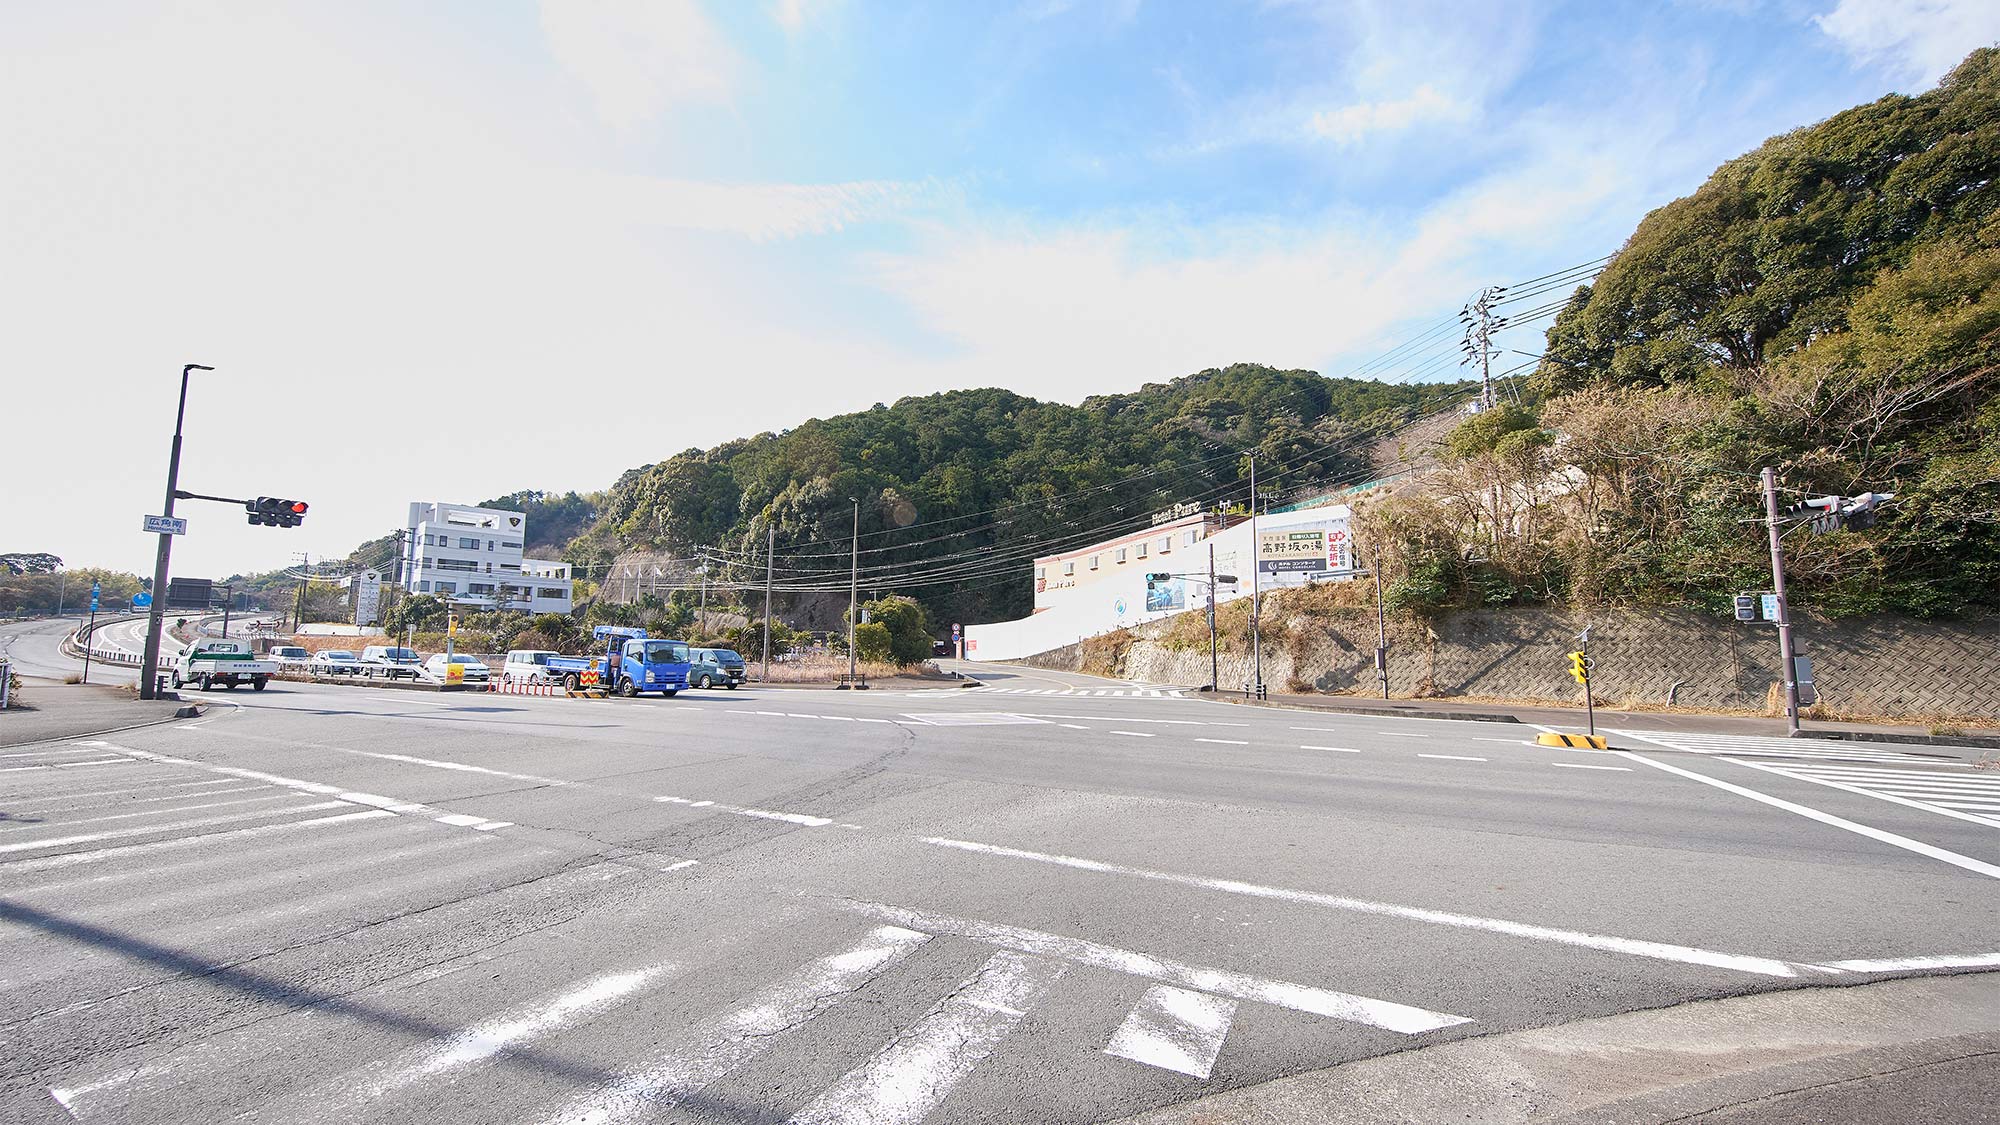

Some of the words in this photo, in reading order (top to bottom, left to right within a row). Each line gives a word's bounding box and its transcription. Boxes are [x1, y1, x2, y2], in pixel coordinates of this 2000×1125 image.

[1152, 509, 1171, 525] Hotel
[1174, 501, 1201, 519] Pure
[1262, 541, 1323, 553] 高野坂の湯
[1328, 543, 1338, 561] 左折
